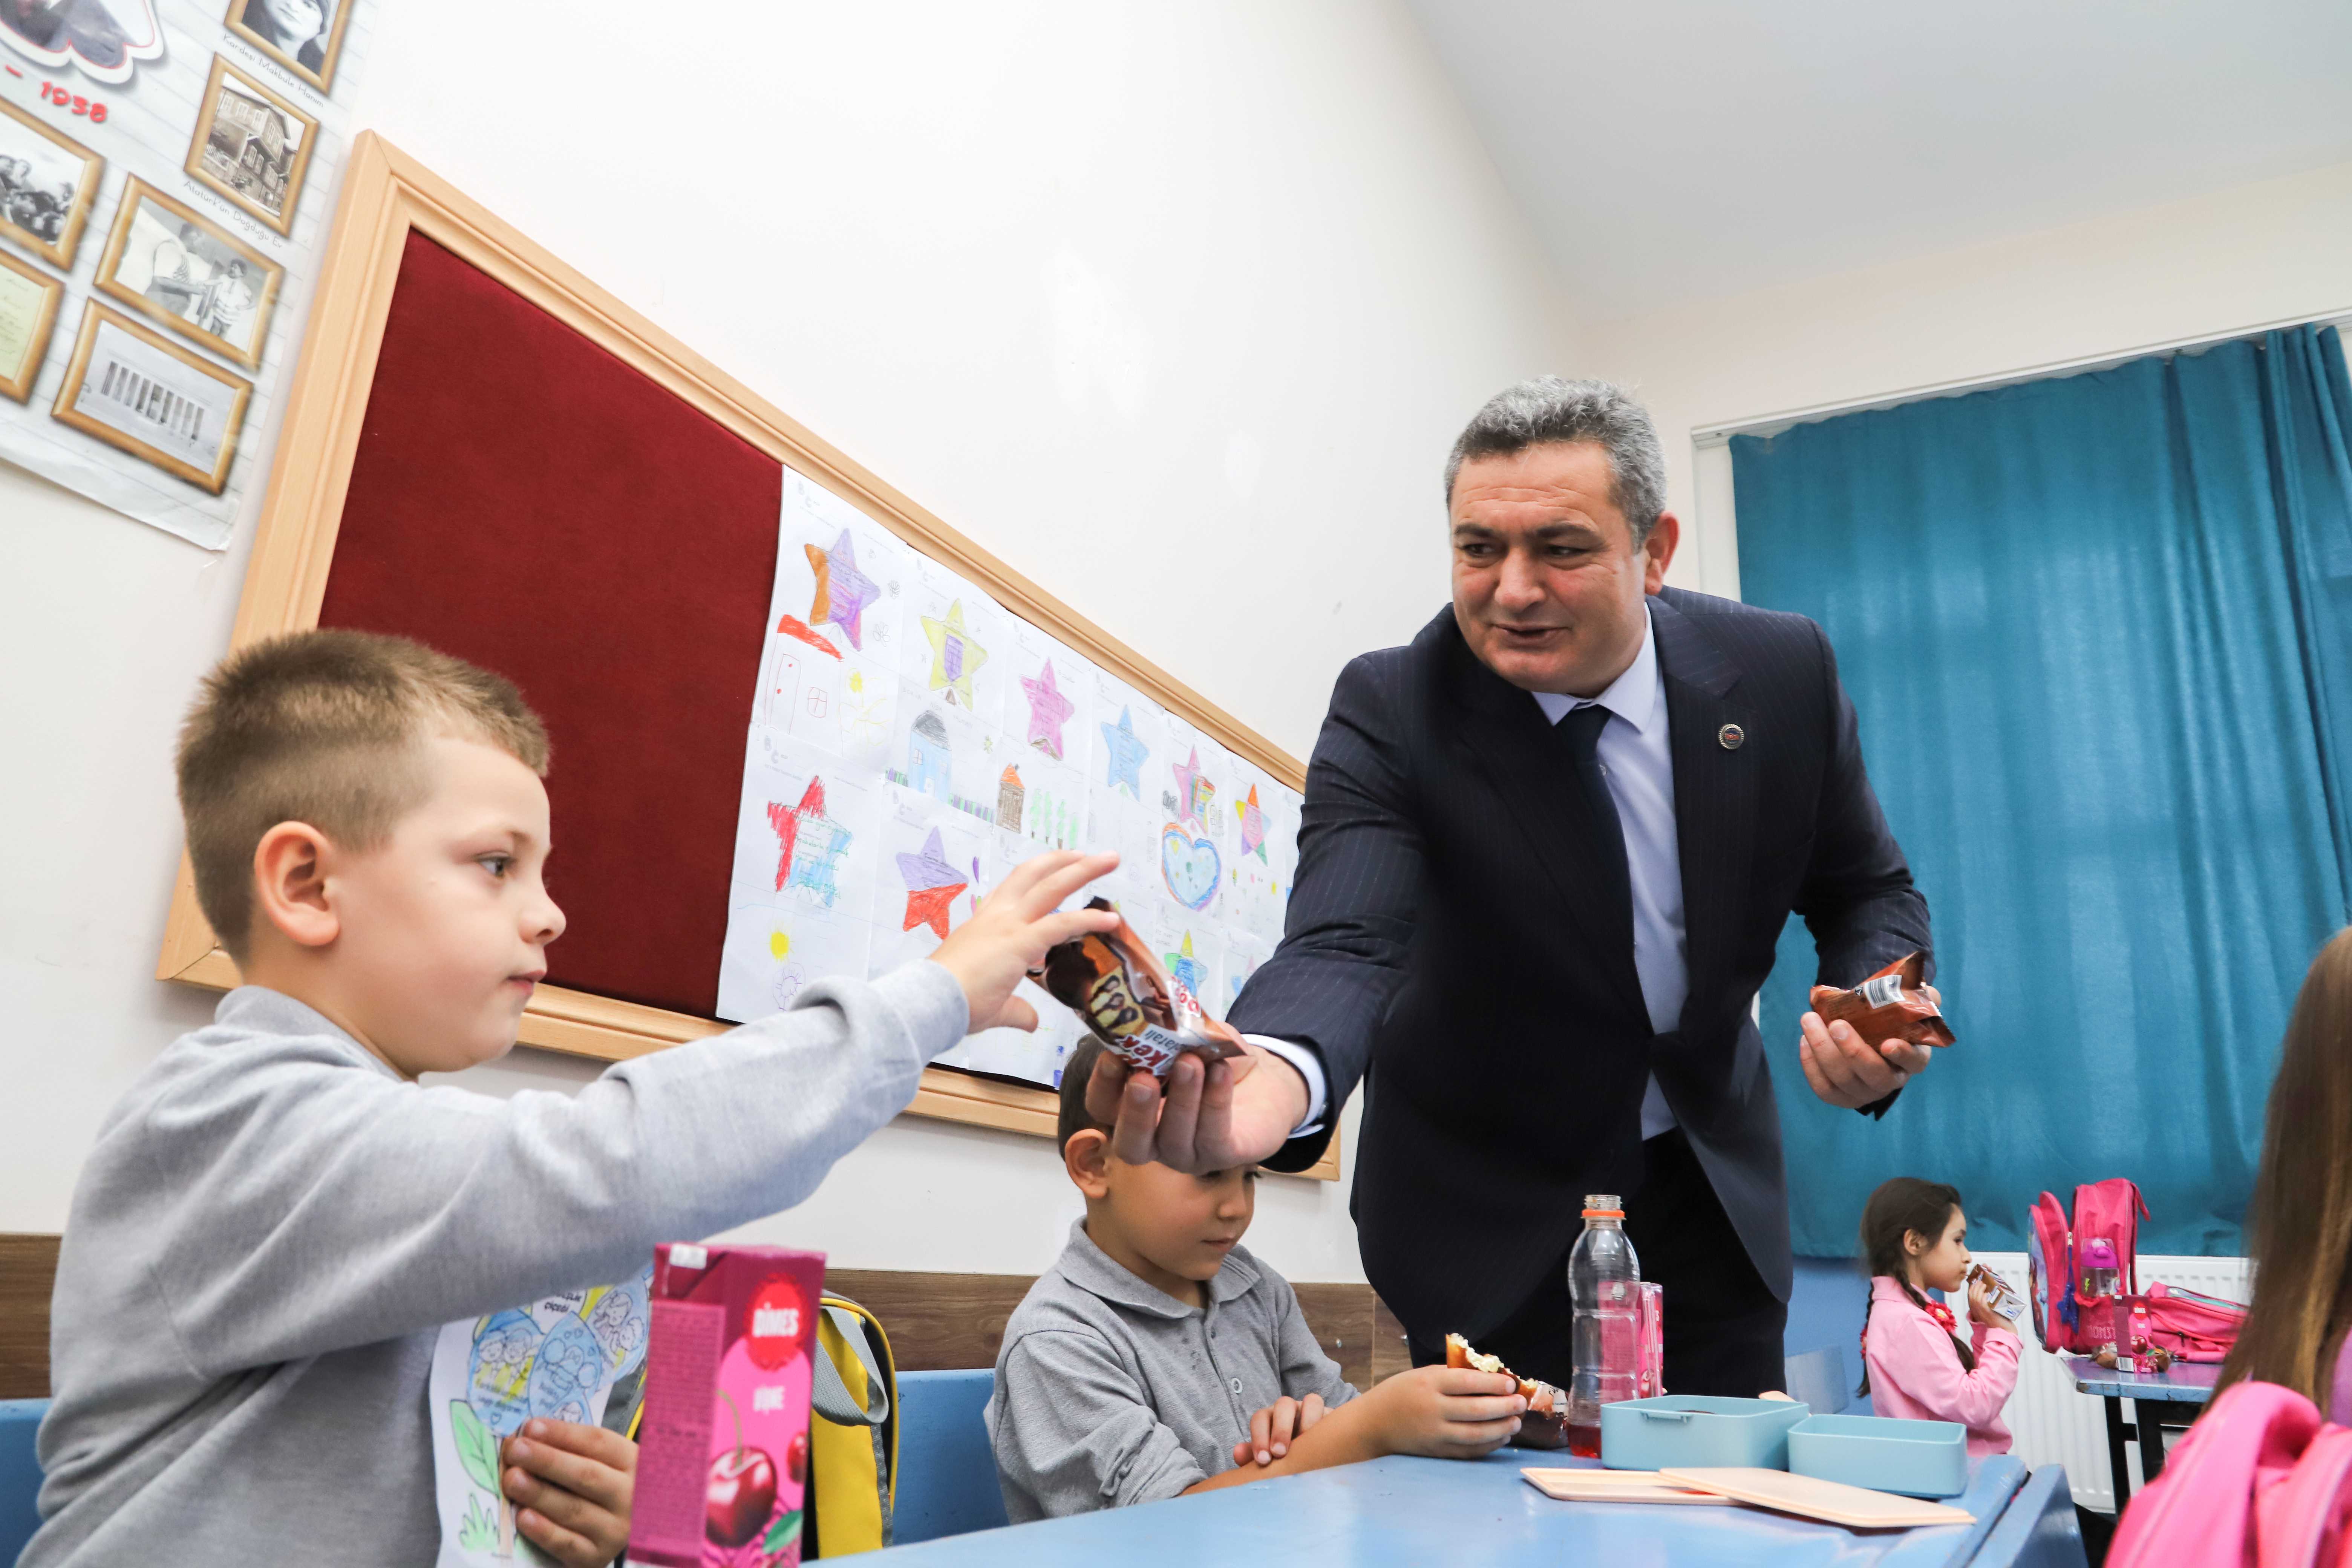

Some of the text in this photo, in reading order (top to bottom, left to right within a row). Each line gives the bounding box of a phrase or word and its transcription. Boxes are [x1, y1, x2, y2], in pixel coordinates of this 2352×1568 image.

[224, 33, 324, 107] Kardeşi Makbule Hanım
[41, 81, 107, 123] 1938
[184, 181, 282, 248] Atatürk'ün Doğduğu Ev
[1145, 1029, 1182, 1051] latalı
